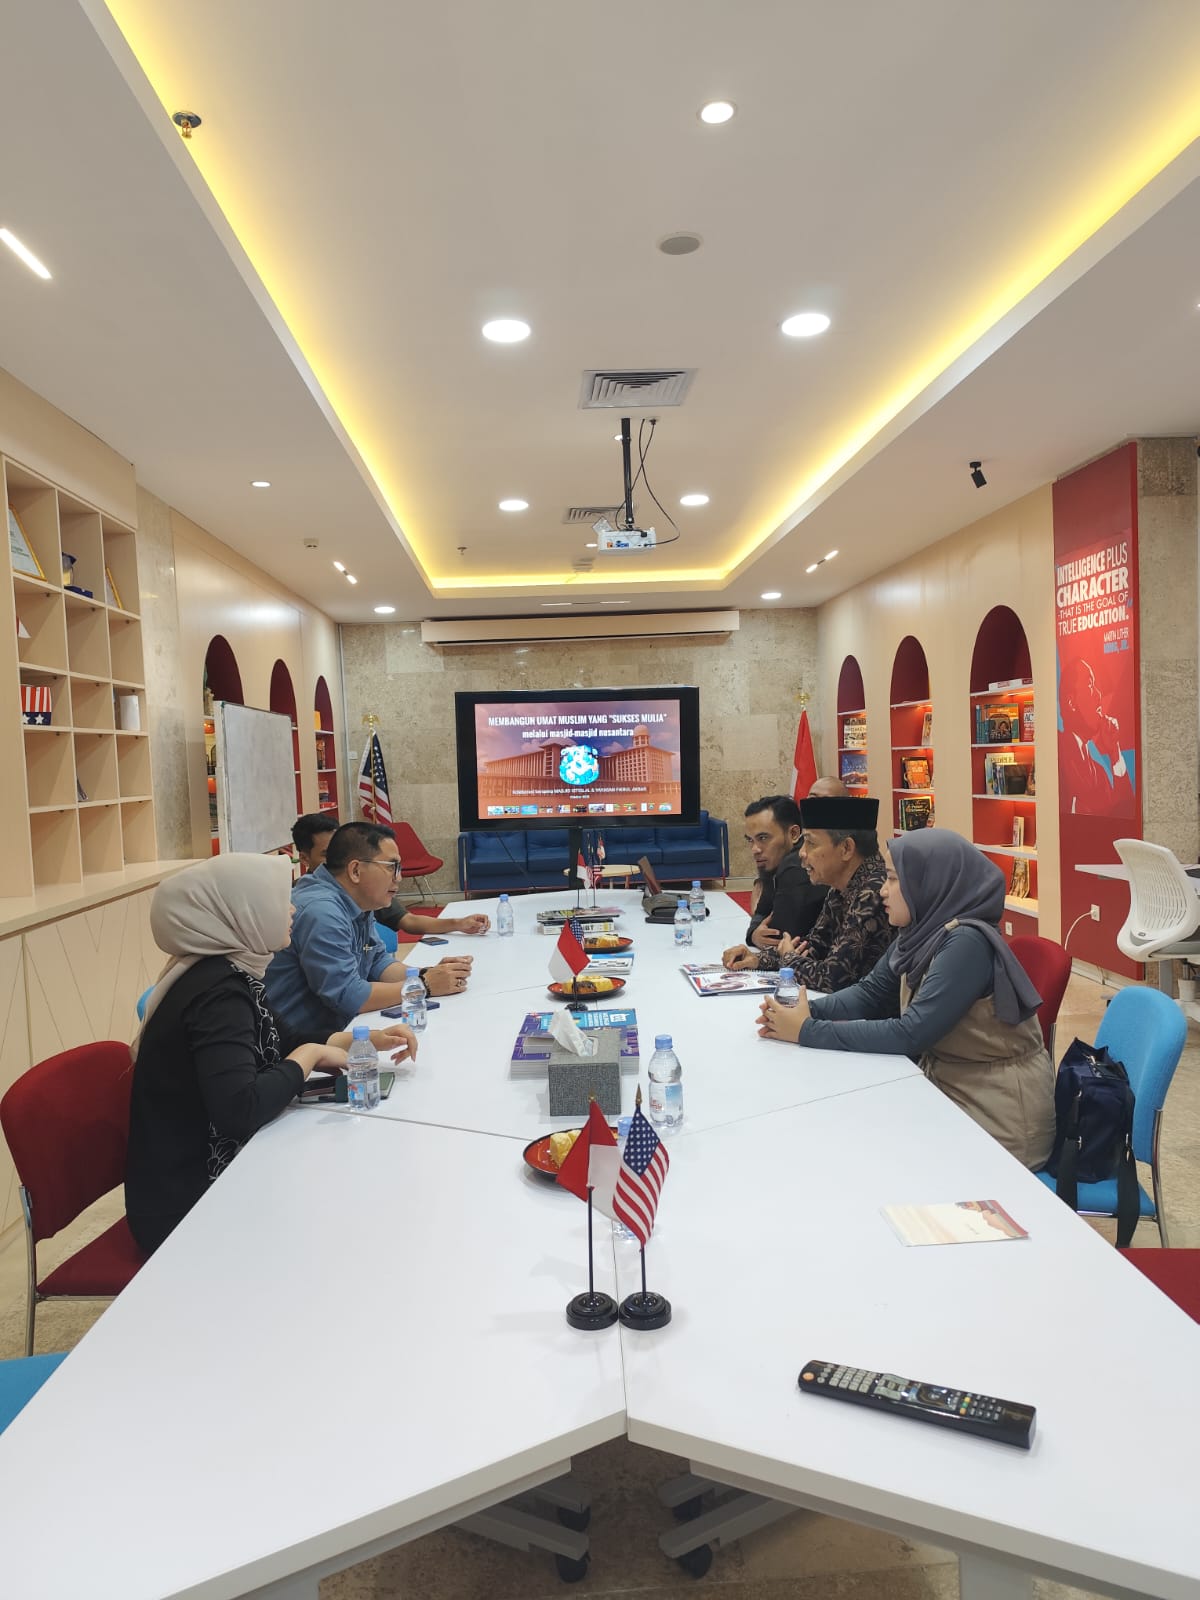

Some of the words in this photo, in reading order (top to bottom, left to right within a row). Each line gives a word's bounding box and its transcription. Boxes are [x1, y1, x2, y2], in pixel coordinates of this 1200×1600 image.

[1057, 551, 1106, 586] INTELLIGENCE
[1106, 542, 1128, 568] PLUS
[1057, 567, 1129, 608] CHARACTER
[1075, 605, 1082, 616] IS
[1083, 601, 1095, 613] THE
[1096, 595, 1116, 609] GOAL
[1118, 591, 1129, 603] OF
[1058, 618, 1077, 637] TRUE
[1077, 605, 1130, 632] EDUCATION.
[488, 716, 535, 727] MEMBANGUN
[536, 715, 557, 726] UMAT
[558, 715, 587, 725] MUSLIM
[588, 714, 608, 724] YANG
[608, 713, 640, 724] "SUKSES
[641, 713, 668, 723] MULIA"
[522, 729, 549, 739] melalui
[549, 728, 598, 739] masjid-masjid
[598, 728, 634, 737] nusantara
